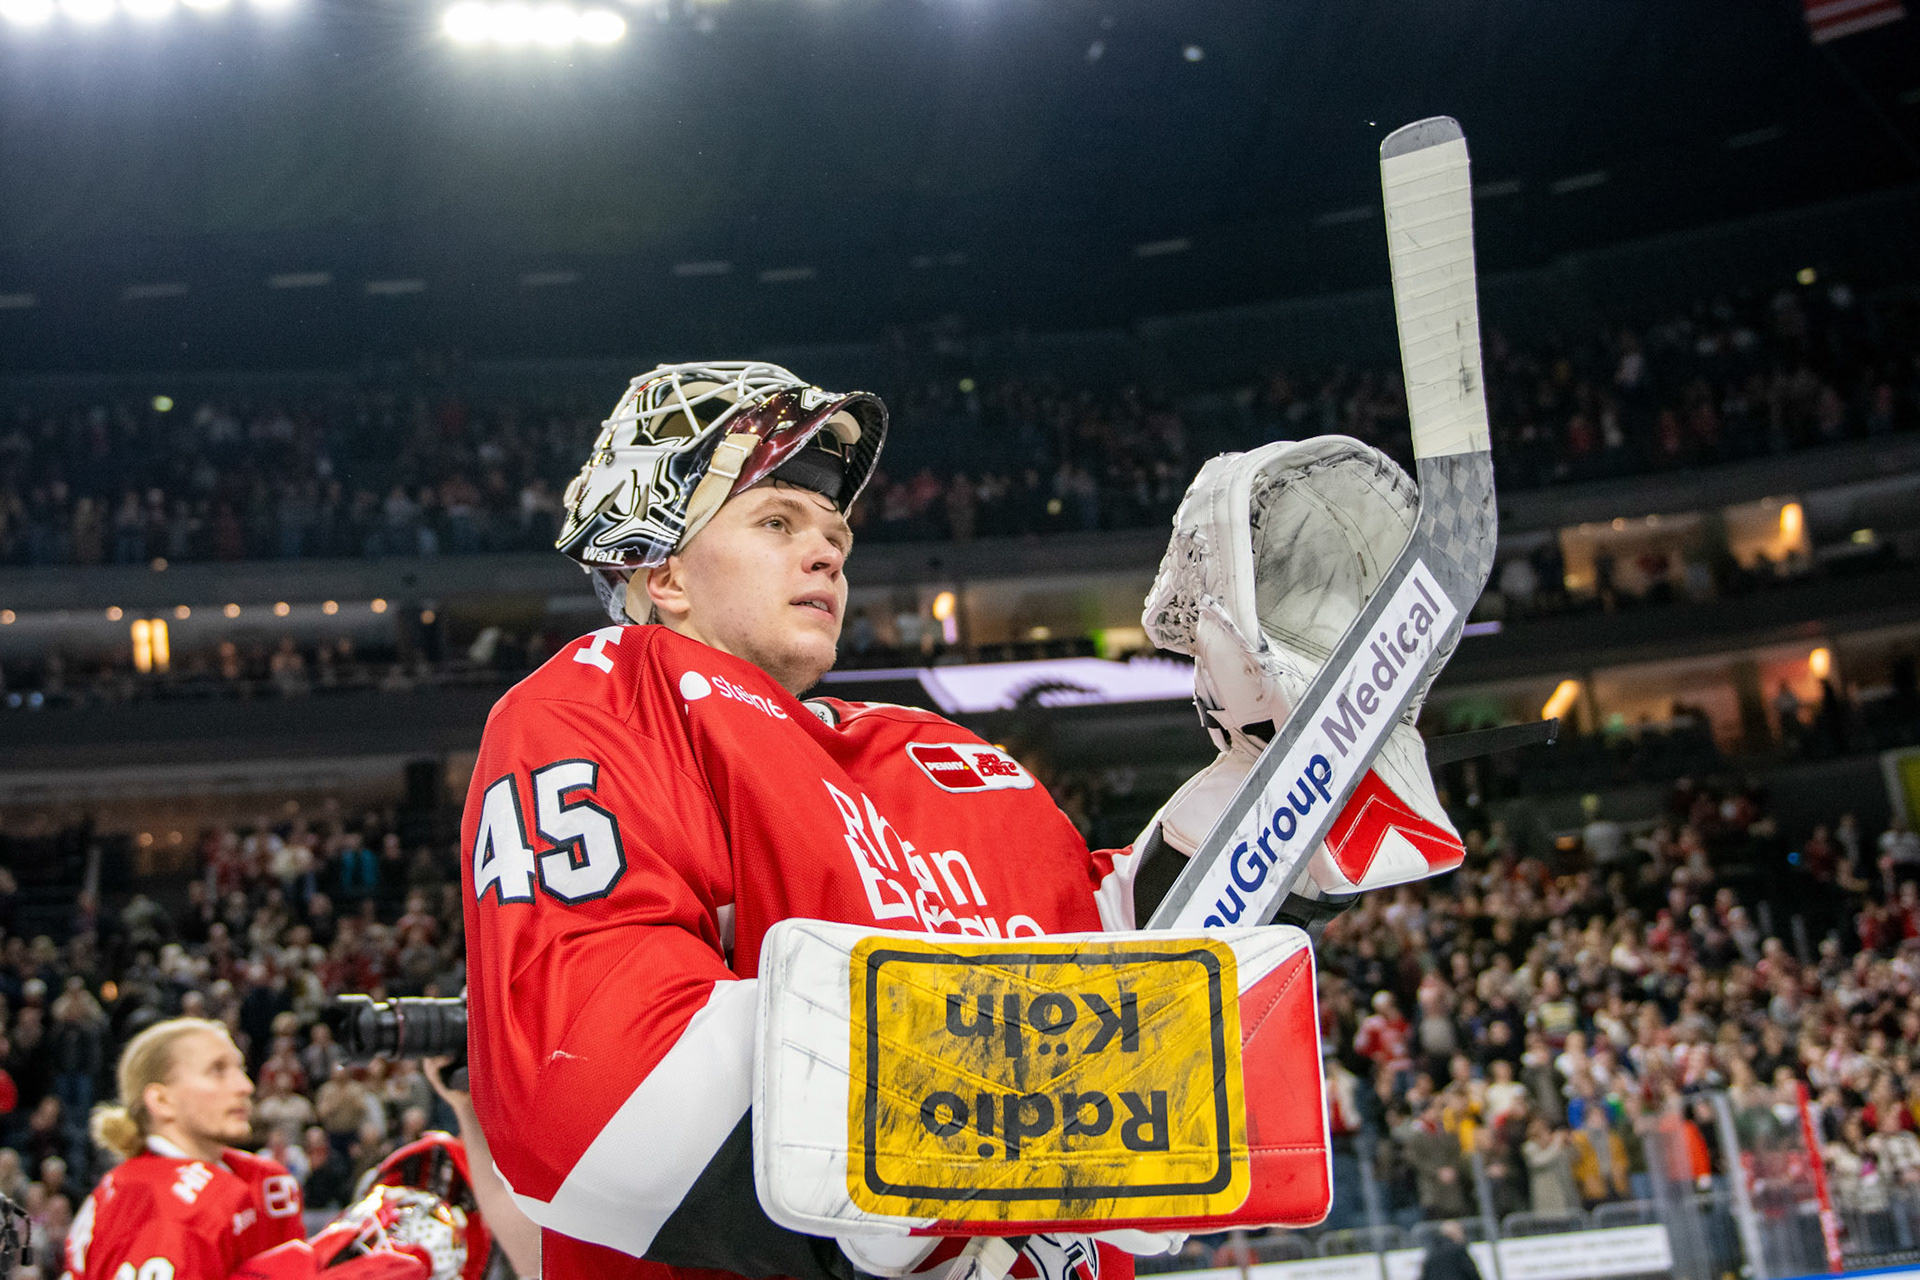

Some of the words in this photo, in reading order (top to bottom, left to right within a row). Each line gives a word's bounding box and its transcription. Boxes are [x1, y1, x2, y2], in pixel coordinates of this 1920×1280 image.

[711, 675, 788, 720] steine
[1320, 576, 1441, 758] Medical
[472, 758, 628, 906] 45
[946, 992, 1139, 1058] Köln
[920, 1090, 1170, 1160] Radio
